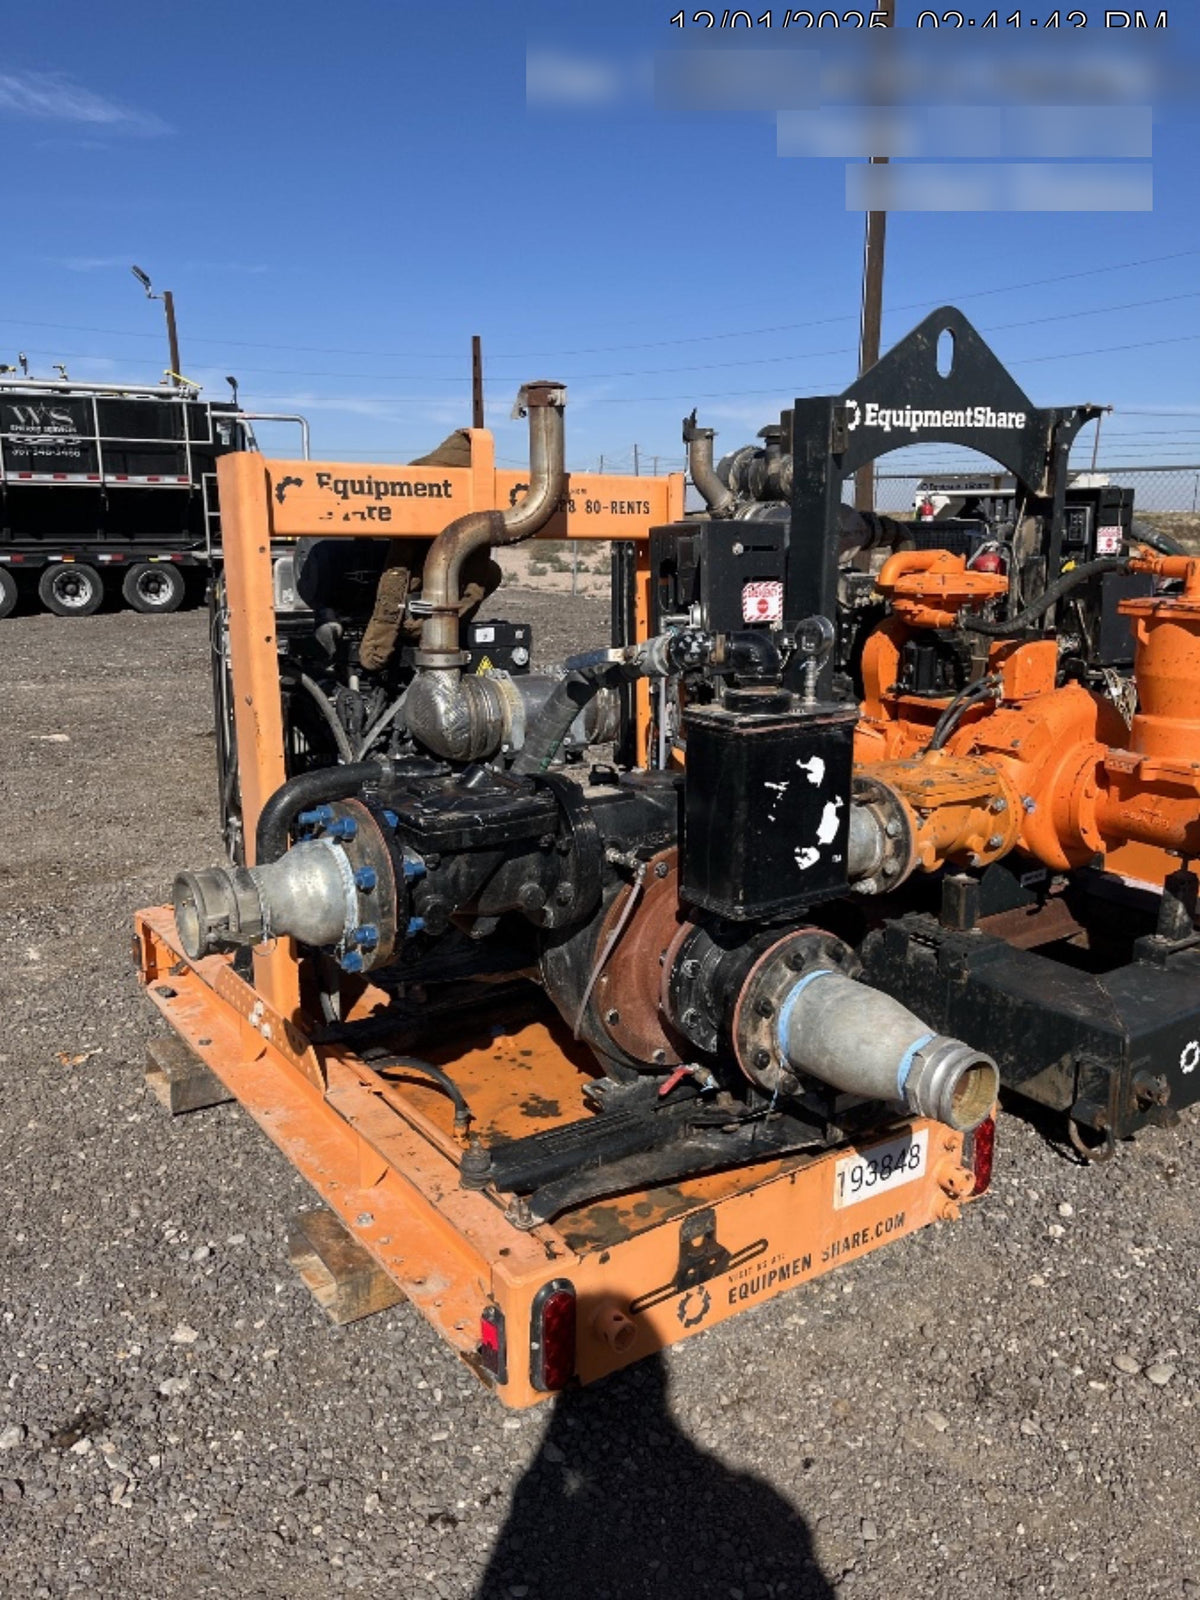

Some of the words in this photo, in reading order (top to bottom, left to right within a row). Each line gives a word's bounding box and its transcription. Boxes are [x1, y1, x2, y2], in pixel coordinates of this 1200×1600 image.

[864, 403, 1026, 432] EquipmentShare
[316, 472, 452, 500] Equipment
[585, 499, 650, 515] 80-RENTS
[837, 1144, 921, 1198] 193848
